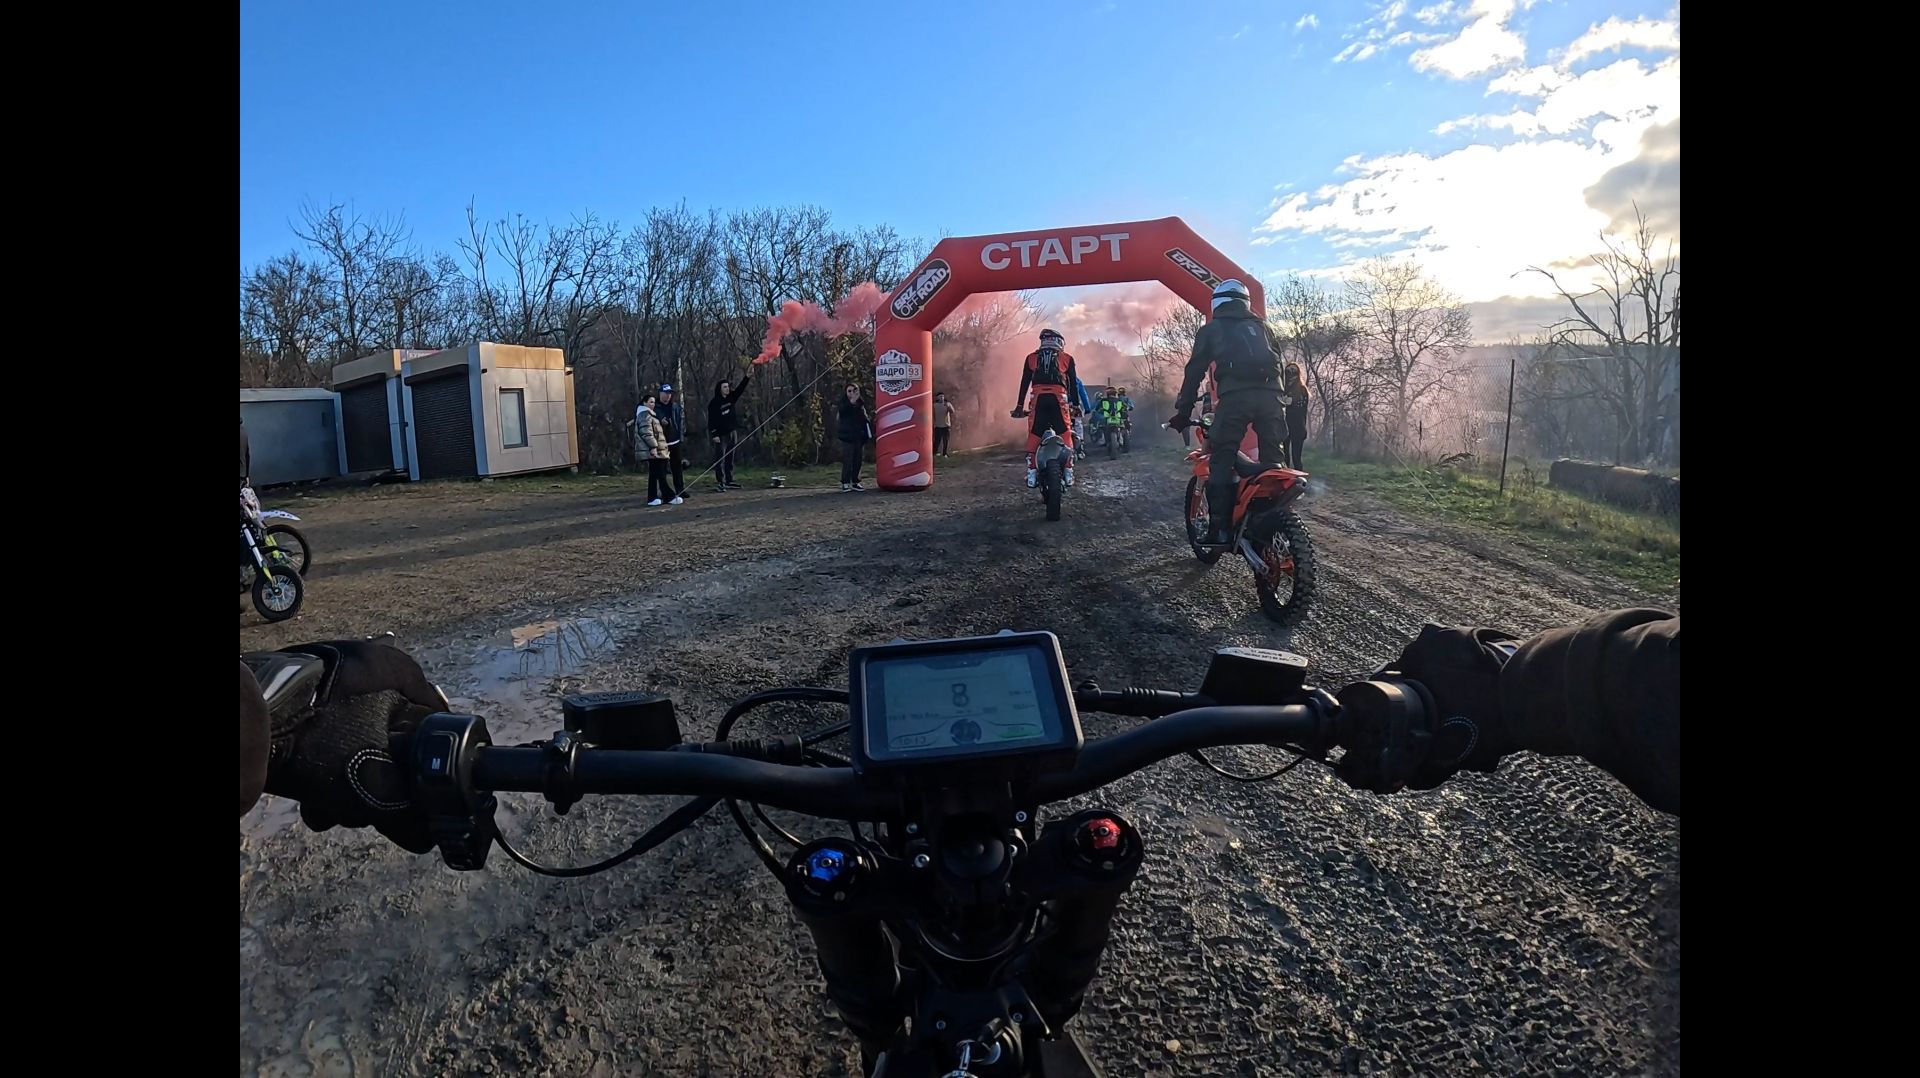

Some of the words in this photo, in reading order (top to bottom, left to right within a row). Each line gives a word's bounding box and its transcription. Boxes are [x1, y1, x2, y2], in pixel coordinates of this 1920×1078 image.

[981, 233, 1129, 270] СТАРТ
[1171, 251, 1208, 278] BRZ
[894, 285, 916, 310] BRZ
[908, 368, 919, 376] 93
[951, 683, 970, 707] 8
[431, 758, 441, 770] M
